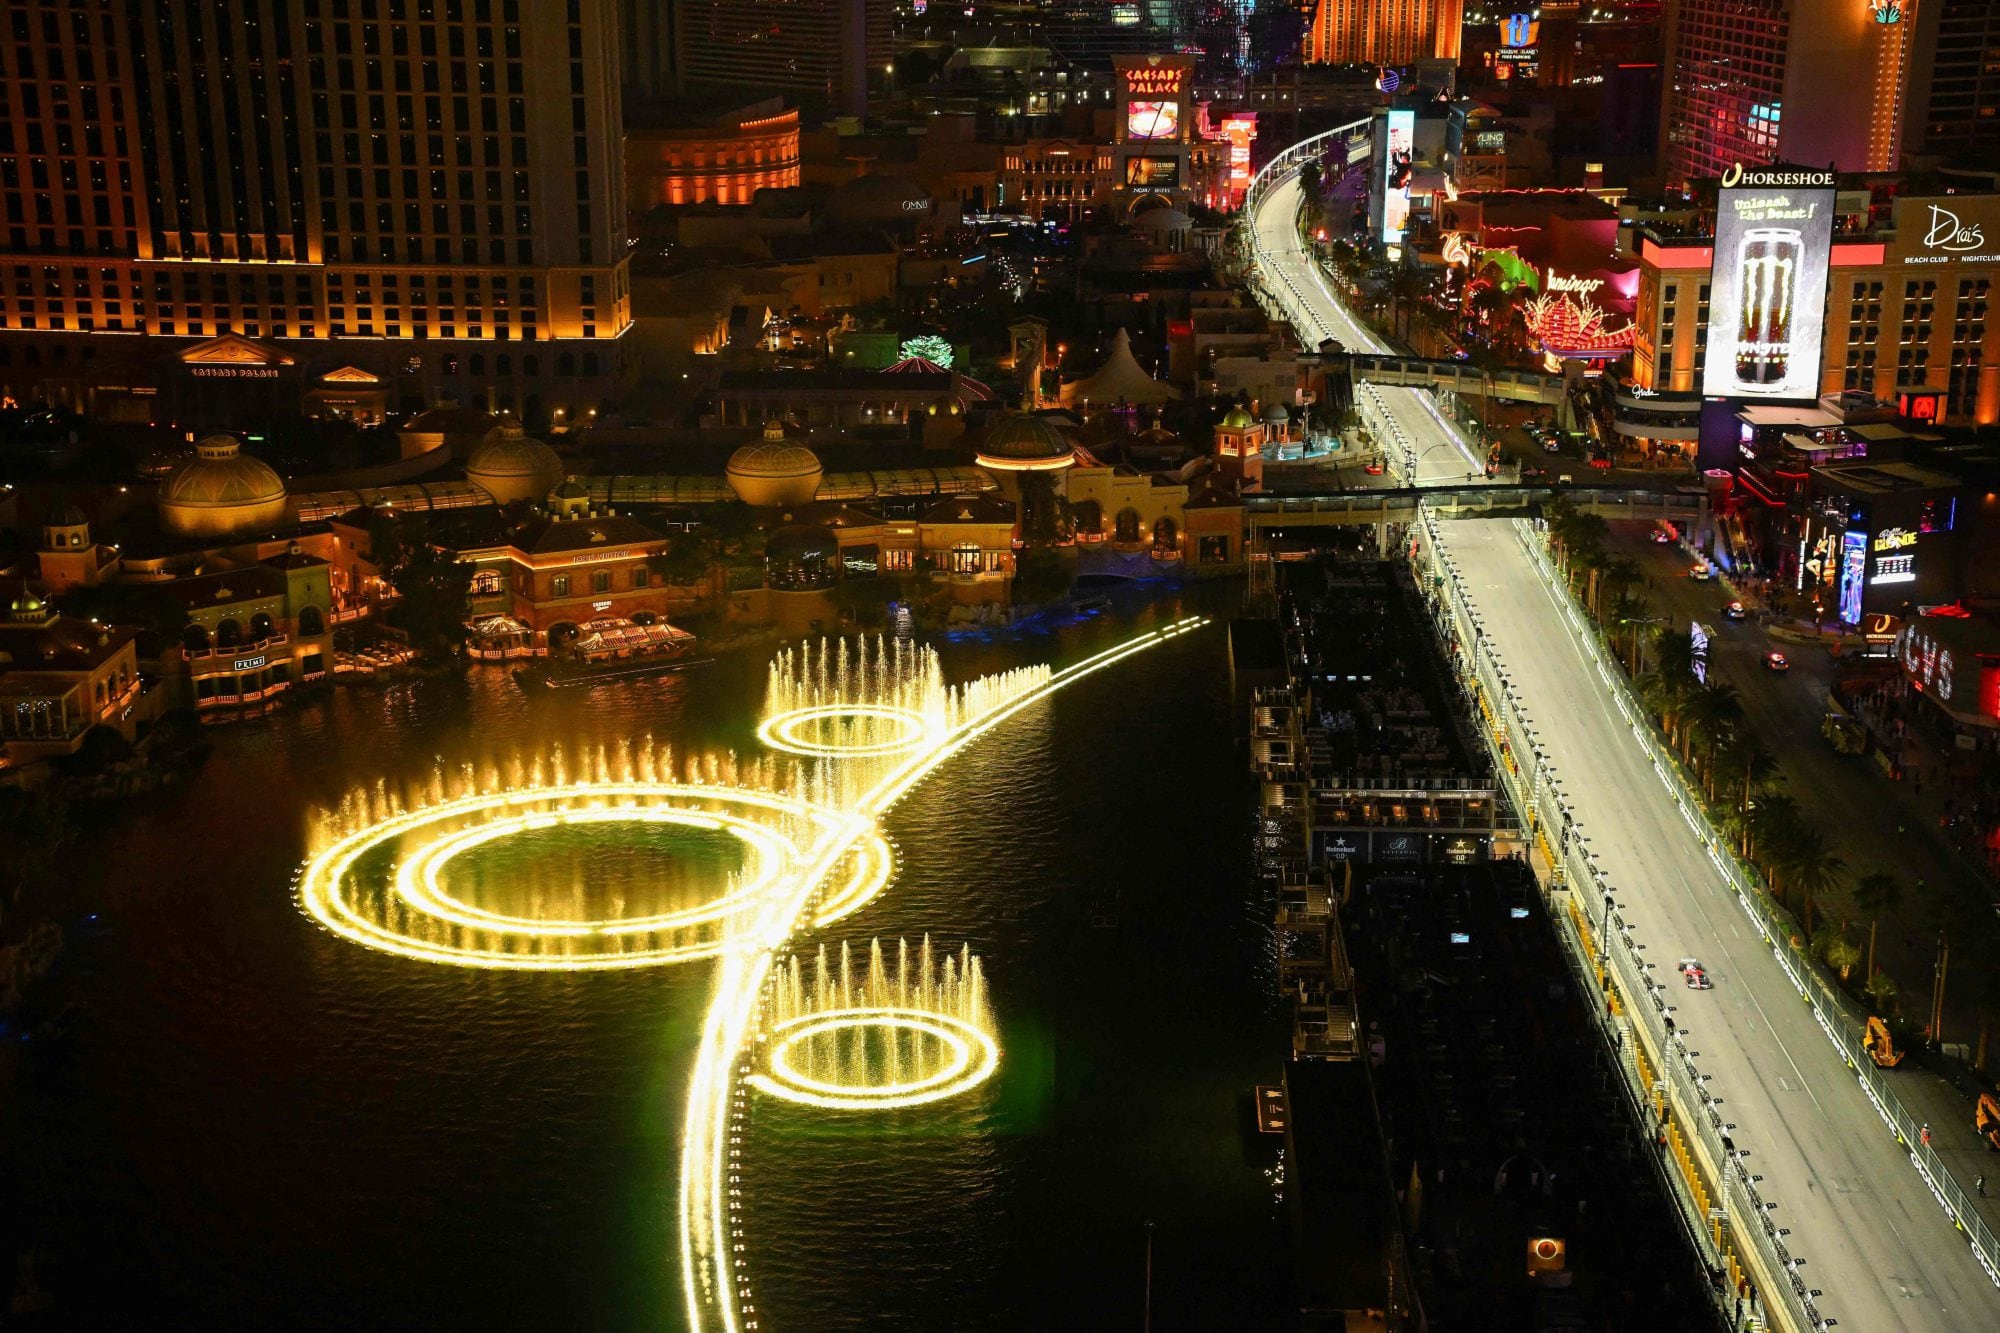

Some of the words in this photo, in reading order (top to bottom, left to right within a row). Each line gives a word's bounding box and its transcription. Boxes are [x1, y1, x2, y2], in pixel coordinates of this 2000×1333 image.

[1126, 70, 1182, 80] CAESARS
[1129, 82, 1179, 93] PALACE
[1742, 173, 1834, 185] HORSESHOE
[1734, 196, 1790, 211] Unleash
[1740, 211, 1765, 221] the
[1924, 205, 1984, 251] Drai's
[238, 658, 263, 668] PRIME
[1813, 1007, 1848, 1062] Globant
[1858, 1075, 1898, 1136] Globant
[1910, 1152, 1955, 1222] Globant
